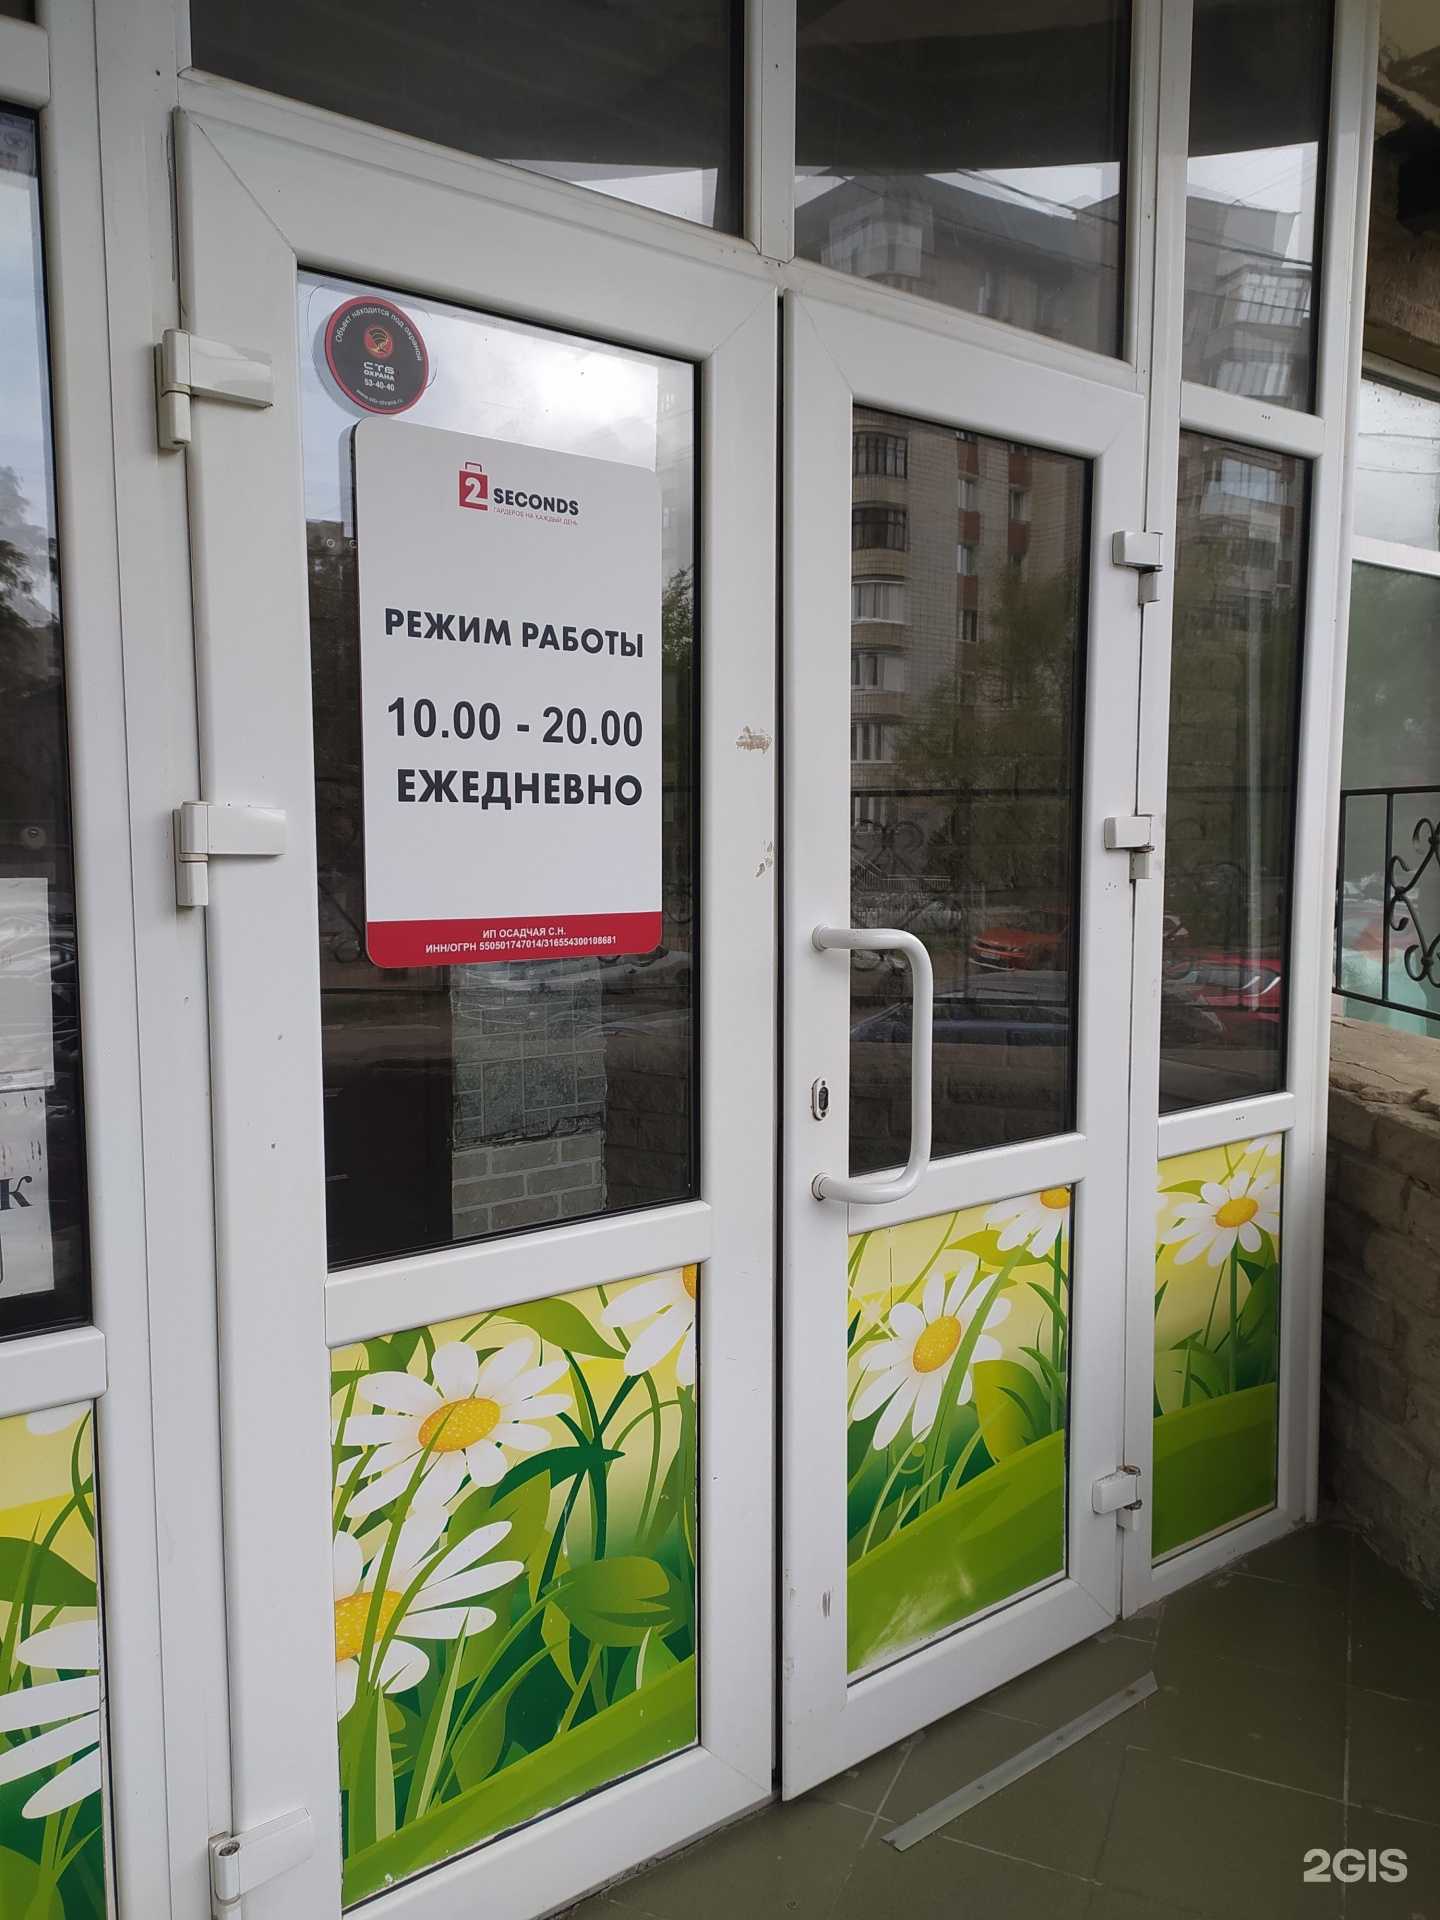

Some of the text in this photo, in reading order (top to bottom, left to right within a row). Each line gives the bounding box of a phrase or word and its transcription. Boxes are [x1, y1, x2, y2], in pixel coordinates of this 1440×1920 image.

[364, 378, 395, 391] 53-40-40
[493, 488, 579, 516] SECONDS
[385, 607, 644, 658] РЕЖИМ РАБОТЫ
[387, 696, 643, 747] 10.00 - 20.00
[397, 768, 643, 811] ЕЖЕДНЕВНО
[482, 926, 567, 939] ИП ОСАДЧАЯ С.Н.
[425, 942, 477, 954] ИНН/ОГРН
